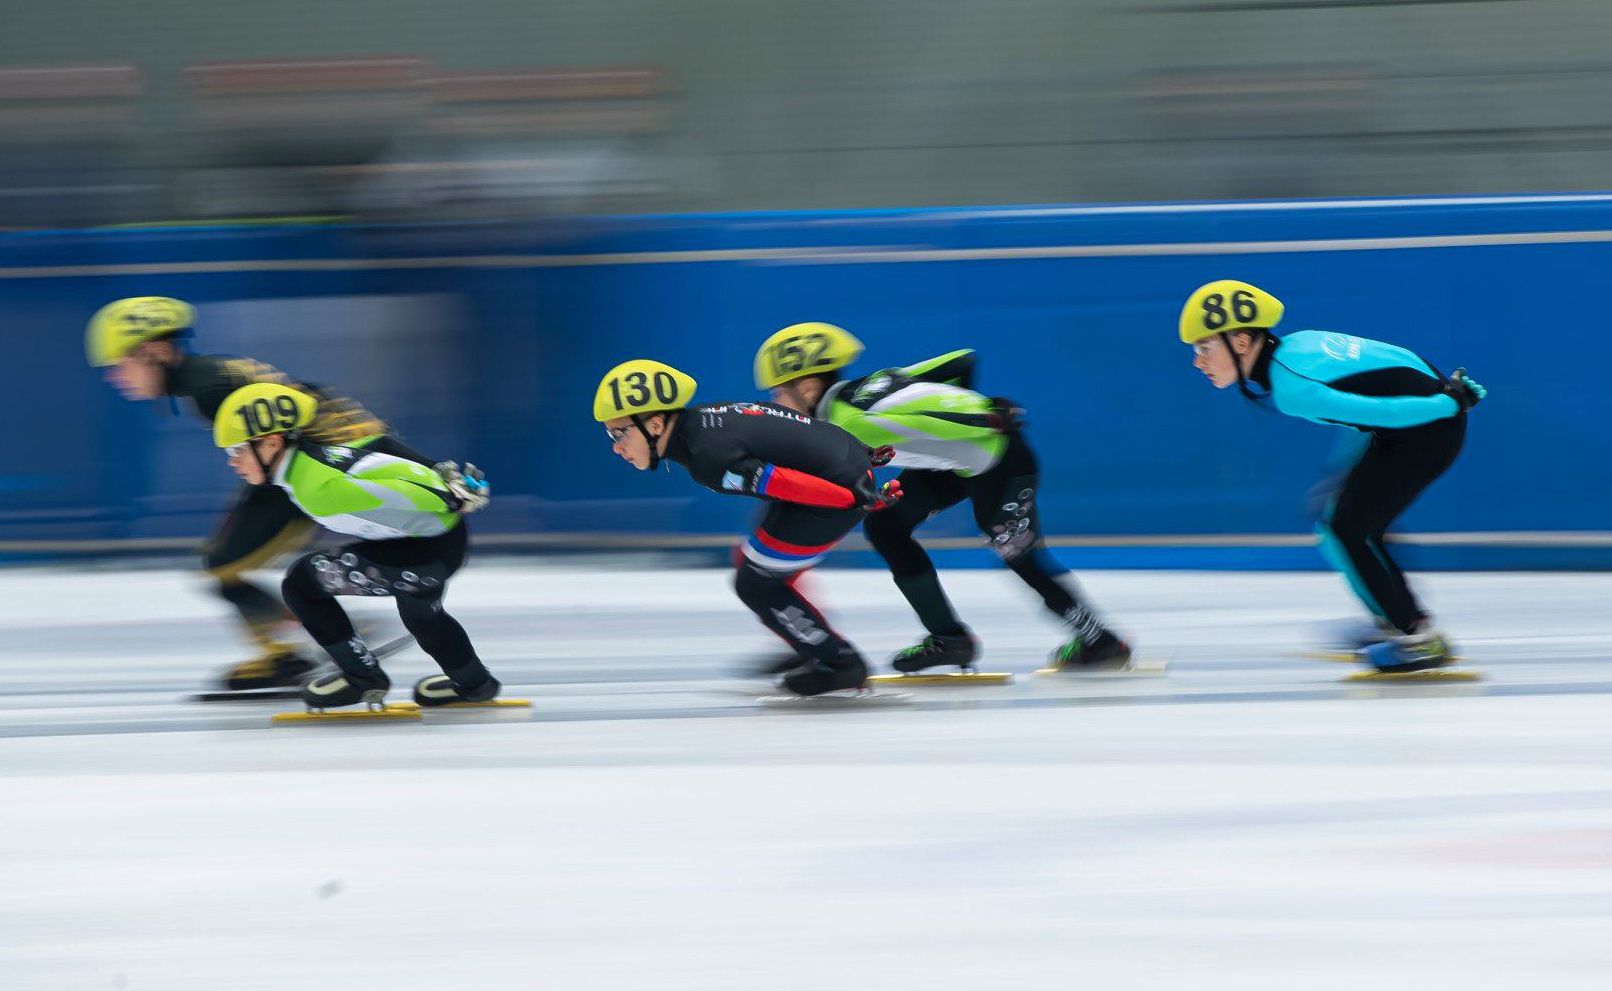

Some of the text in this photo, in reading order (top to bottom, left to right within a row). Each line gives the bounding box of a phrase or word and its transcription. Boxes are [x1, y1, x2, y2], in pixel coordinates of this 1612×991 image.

[1202, 290, 1257, 330] 86
[765, 333, 836, 377] 152
[608, 371, 677, 411] 130
[236, 395, 298, 436] 109
